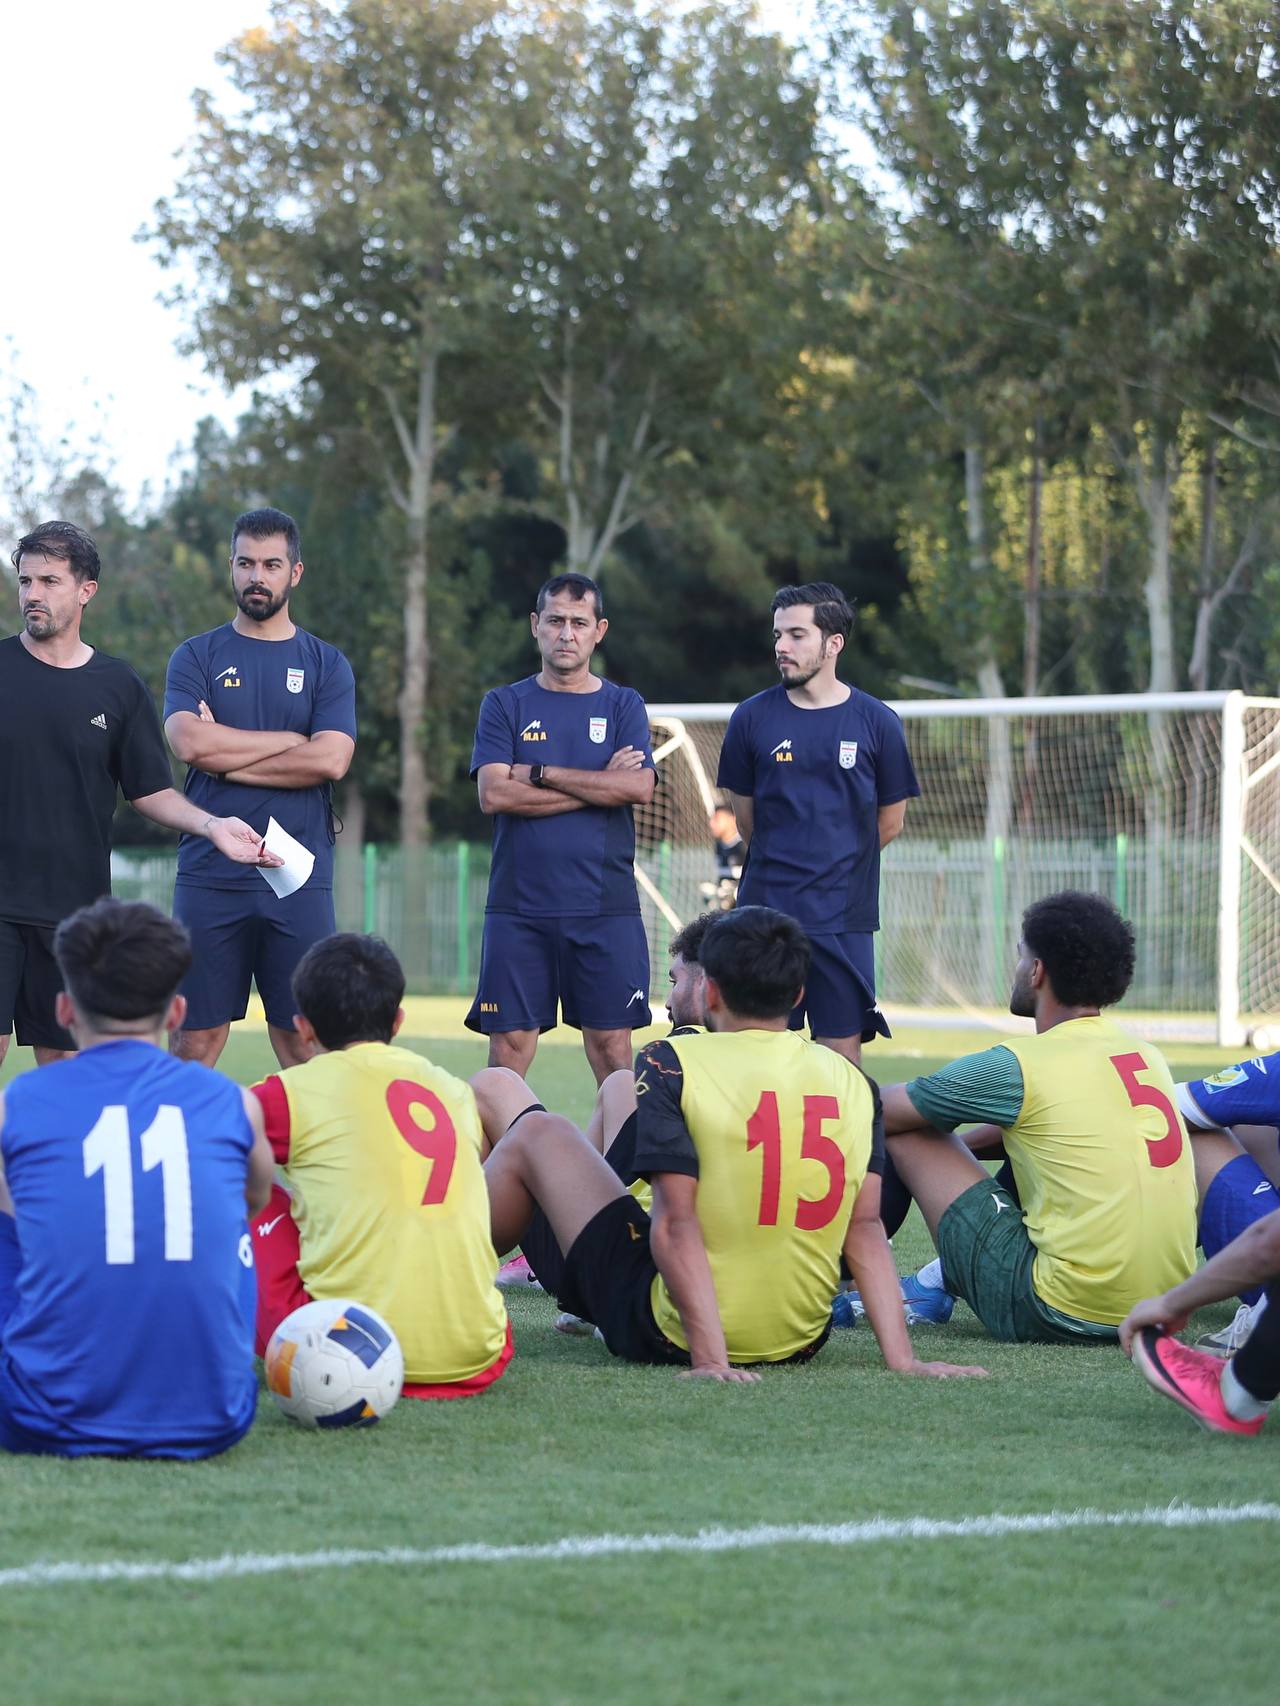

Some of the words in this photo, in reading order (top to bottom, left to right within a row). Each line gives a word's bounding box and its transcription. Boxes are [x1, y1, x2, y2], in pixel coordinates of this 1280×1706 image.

[386, 1078, 456, 1205] 9
[747, 1091, 846, 1231] 15
[1109, 1052, 1183, 1168] 5
[83, 1104, 193, 1264] 11
